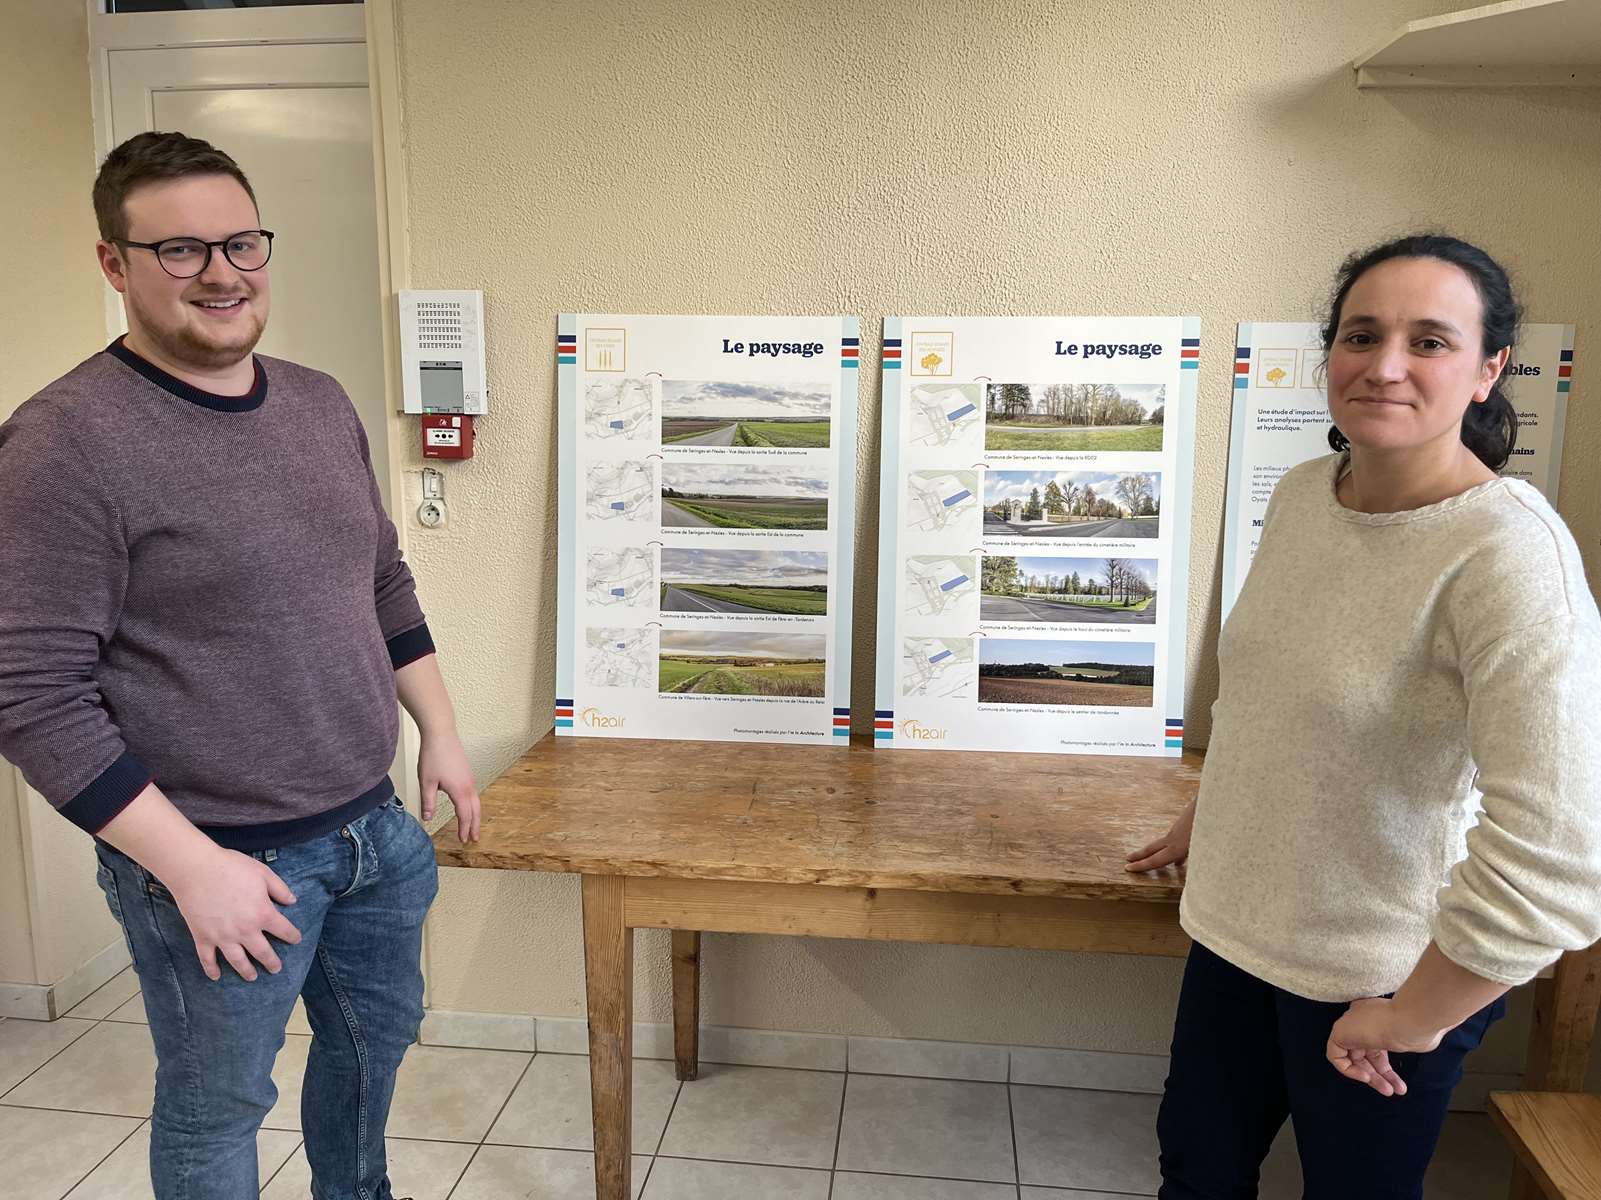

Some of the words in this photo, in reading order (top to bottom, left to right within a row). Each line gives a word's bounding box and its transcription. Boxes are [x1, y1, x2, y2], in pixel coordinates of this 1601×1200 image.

[722, 339, 744, 354] Le
[748, 342, 824, 358] paysage
[1055, 341, 1078, 355] Le
[1082, 343, 1163, 359] paysage
[1288, 408, 1316, 417] d'impact
[1273, 417, 1301, 425] analyses
[1301, 417, 1325, 425] portent
[1263, 425, 1303, 433] hydraulique.
[591, 712, 626, 728] h2air
[912, 724, 948, 739] h2air
